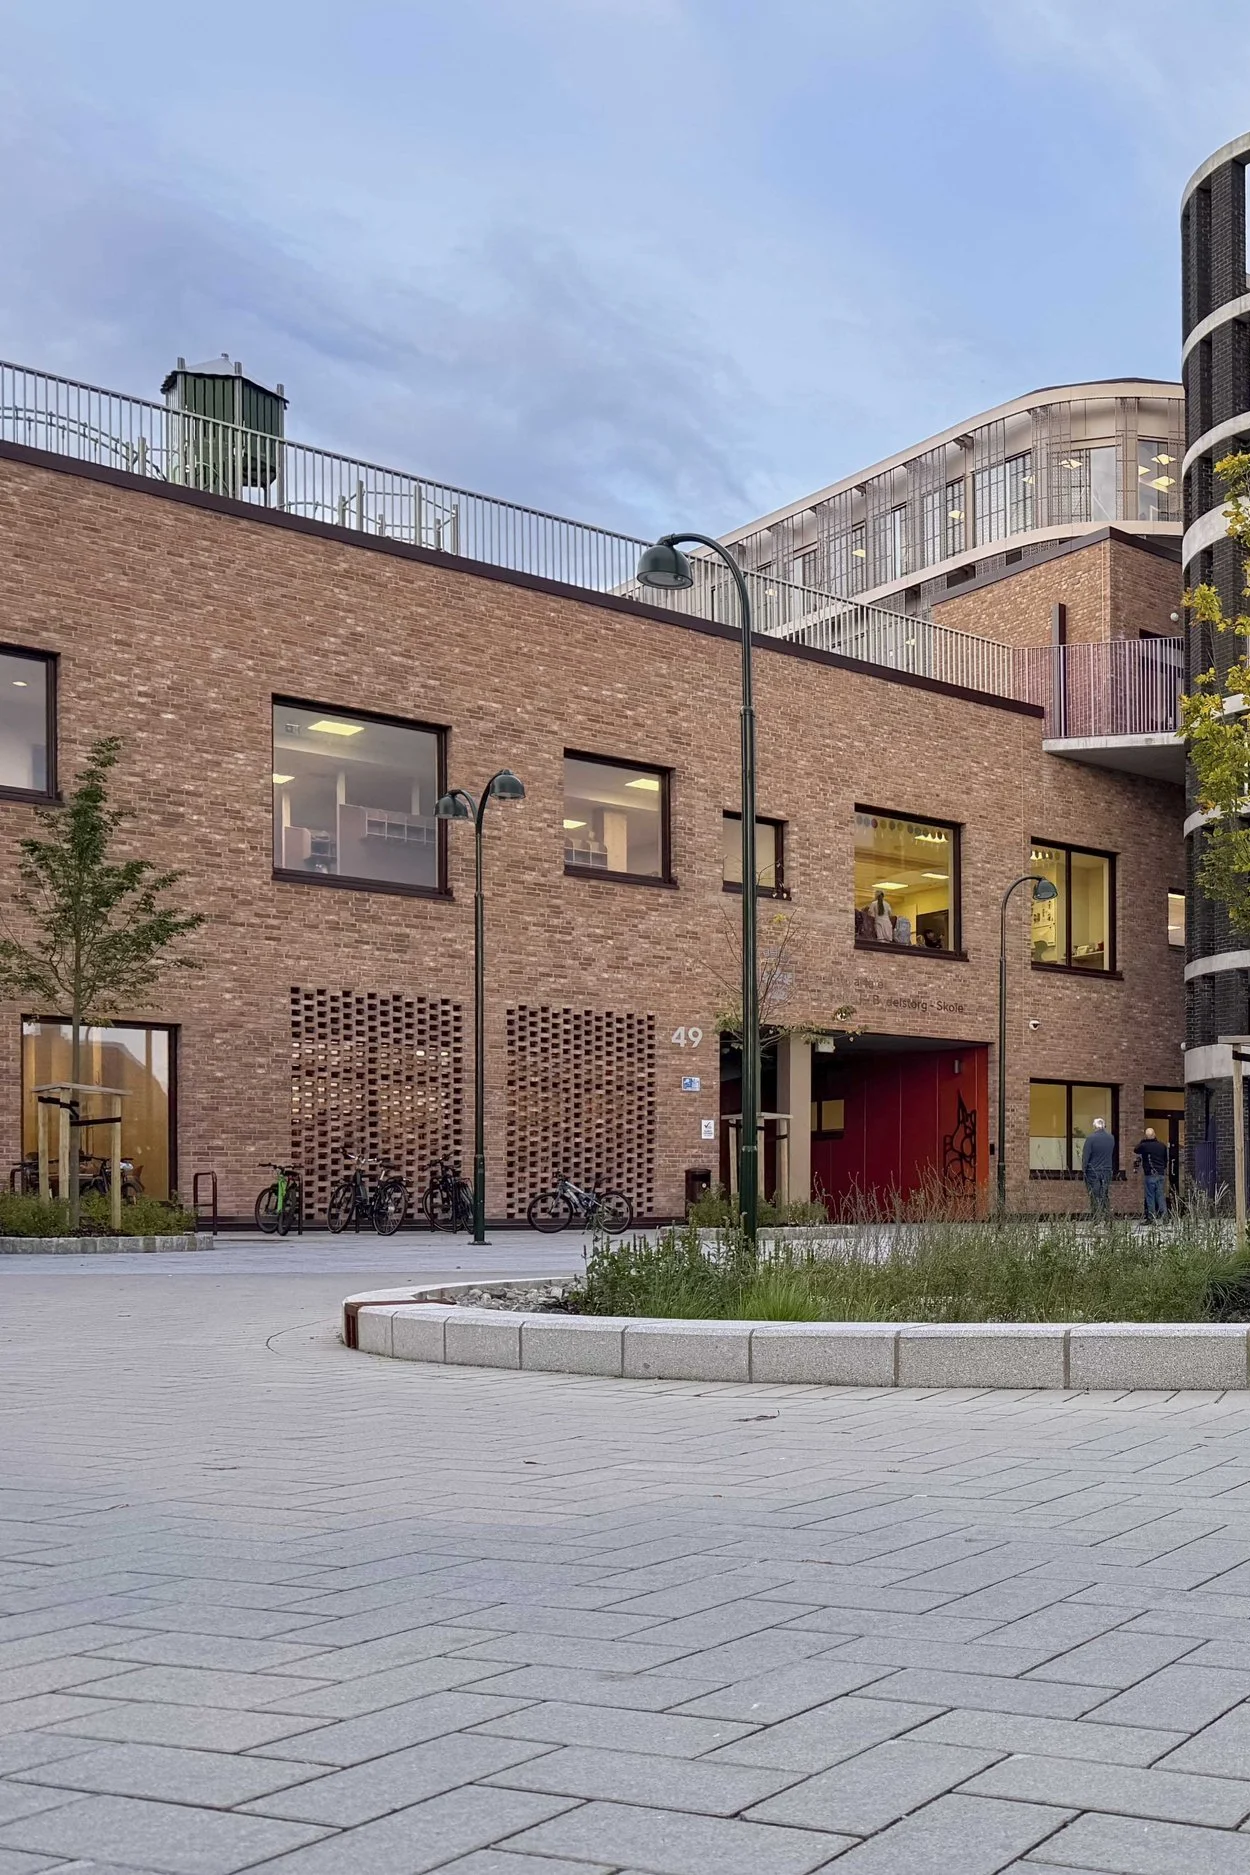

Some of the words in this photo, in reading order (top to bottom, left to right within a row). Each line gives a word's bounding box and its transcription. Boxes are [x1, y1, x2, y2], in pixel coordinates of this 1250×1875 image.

[872, 994, 929, 1013] Bdelstorg
[936, 1000, 964, 1013] Skole
[671, 1027, 703, 1048] 49
